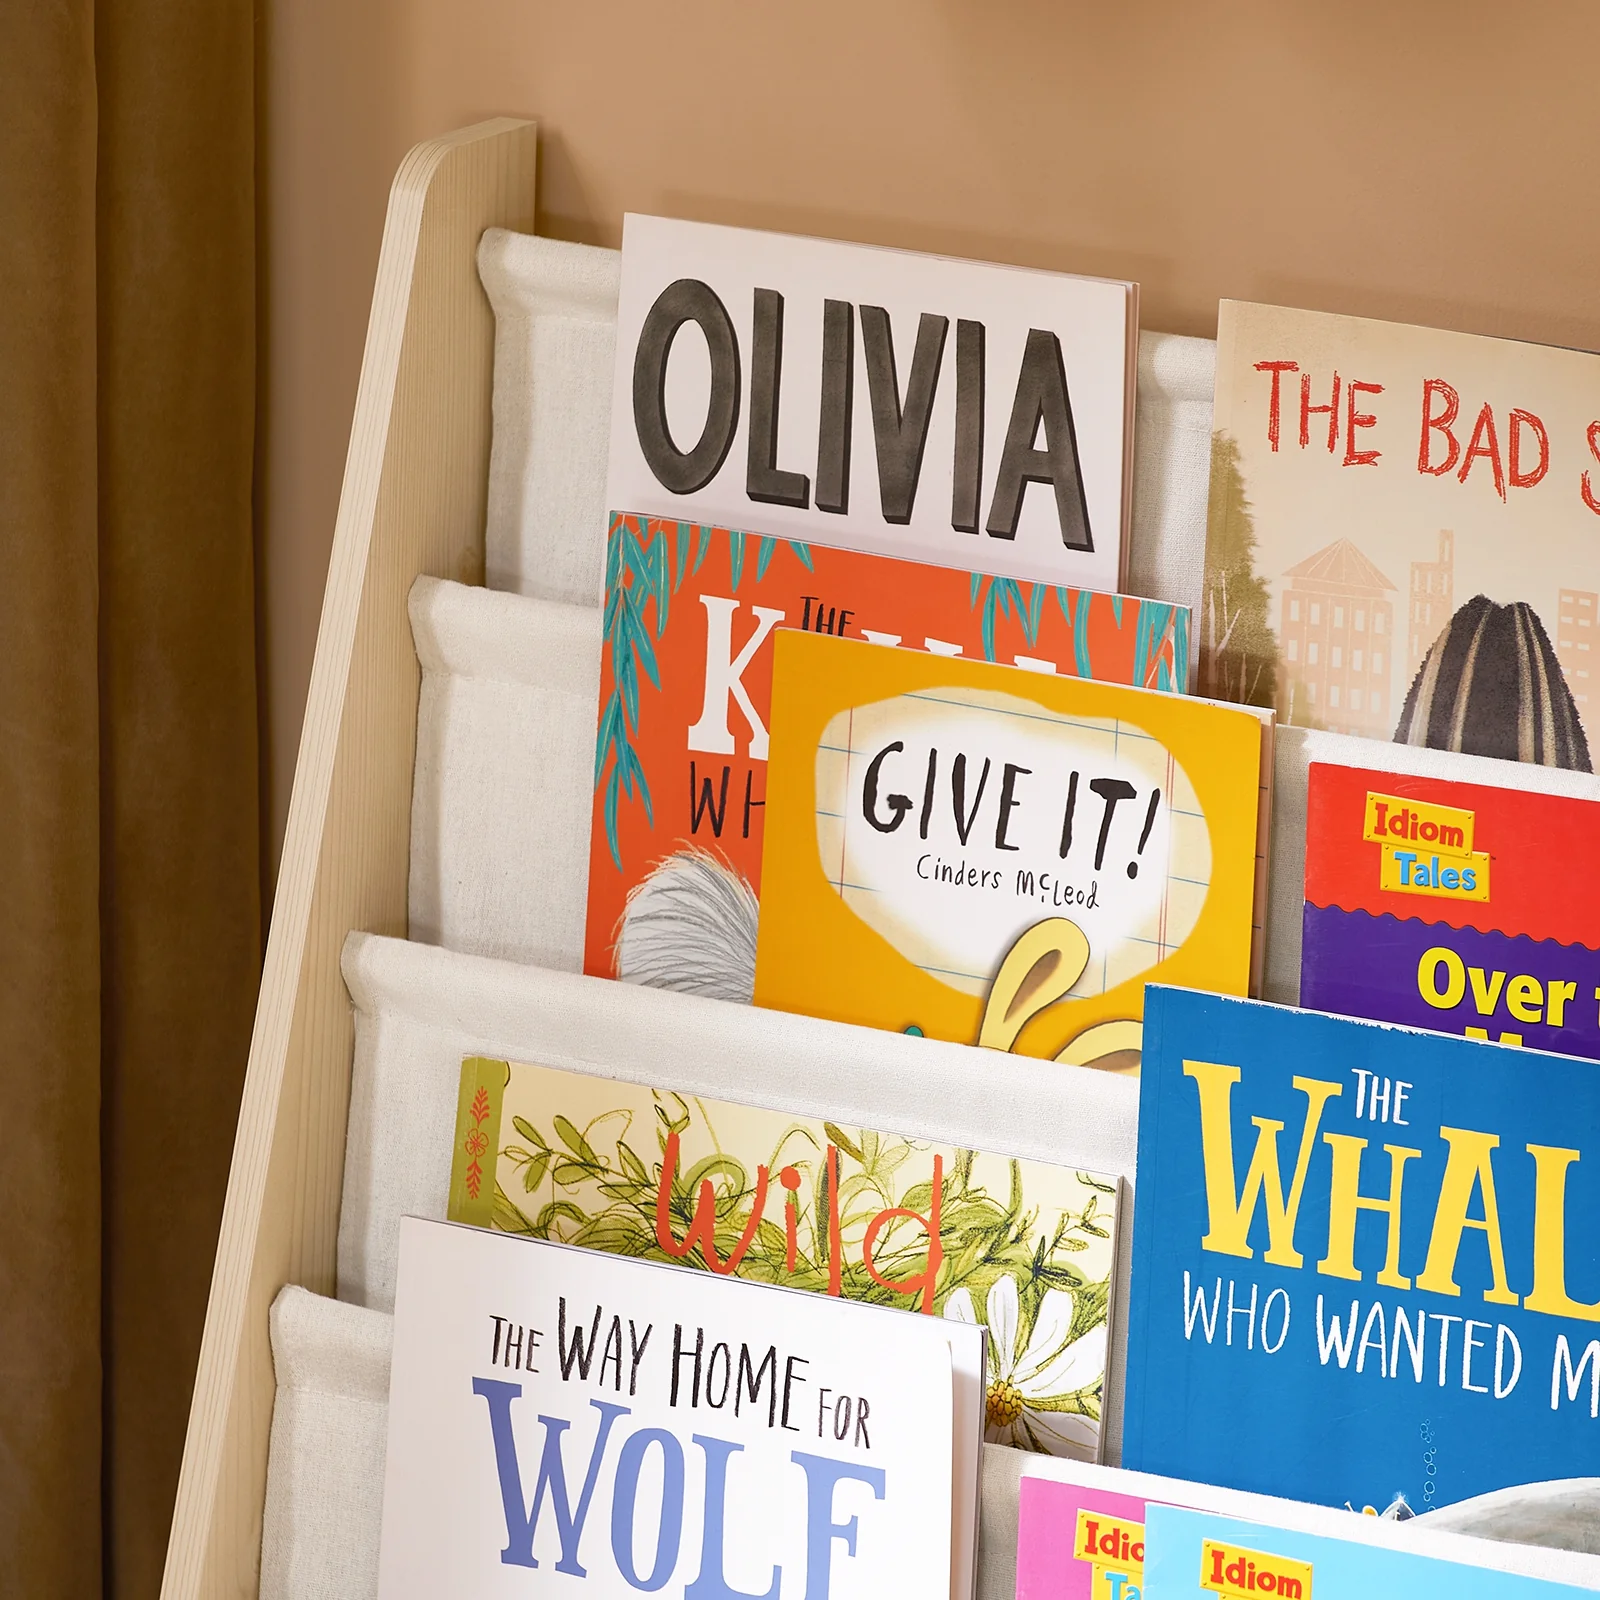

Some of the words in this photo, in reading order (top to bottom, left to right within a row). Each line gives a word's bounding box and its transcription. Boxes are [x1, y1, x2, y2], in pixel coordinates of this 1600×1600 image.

[633, 278, 1095, 552] OLIVIA
[1253, 360, 1385, 467] THE
[1417, 377, 1550, 504] BAD
[862, 741, 1033, 851] GIVE
[1058, 770, 1161, 880] IT!
[1374, 802, 1464, 848] Idiom
[917, 854, 1002, 889] Cinders
[1394, 851, 1477, 891] Tales
[1417, 946, 1578, 1028] Over
[1351, 1068, 1414, 1126] THE
[489, 1314, 544, 1373] THE
[558, 1297, 653, 1396] WAY
[670, 1323, 809, 1431] HOME
[818, 1388, 871, 1449] FOR
[1183, 1270, 1291, 1354] WHO
[1316, 1294, 1523, 1400] WANTED
[472, 1376, 886, 1600] WOLF
[1210, 1549, 1303, 1600] Idiom
